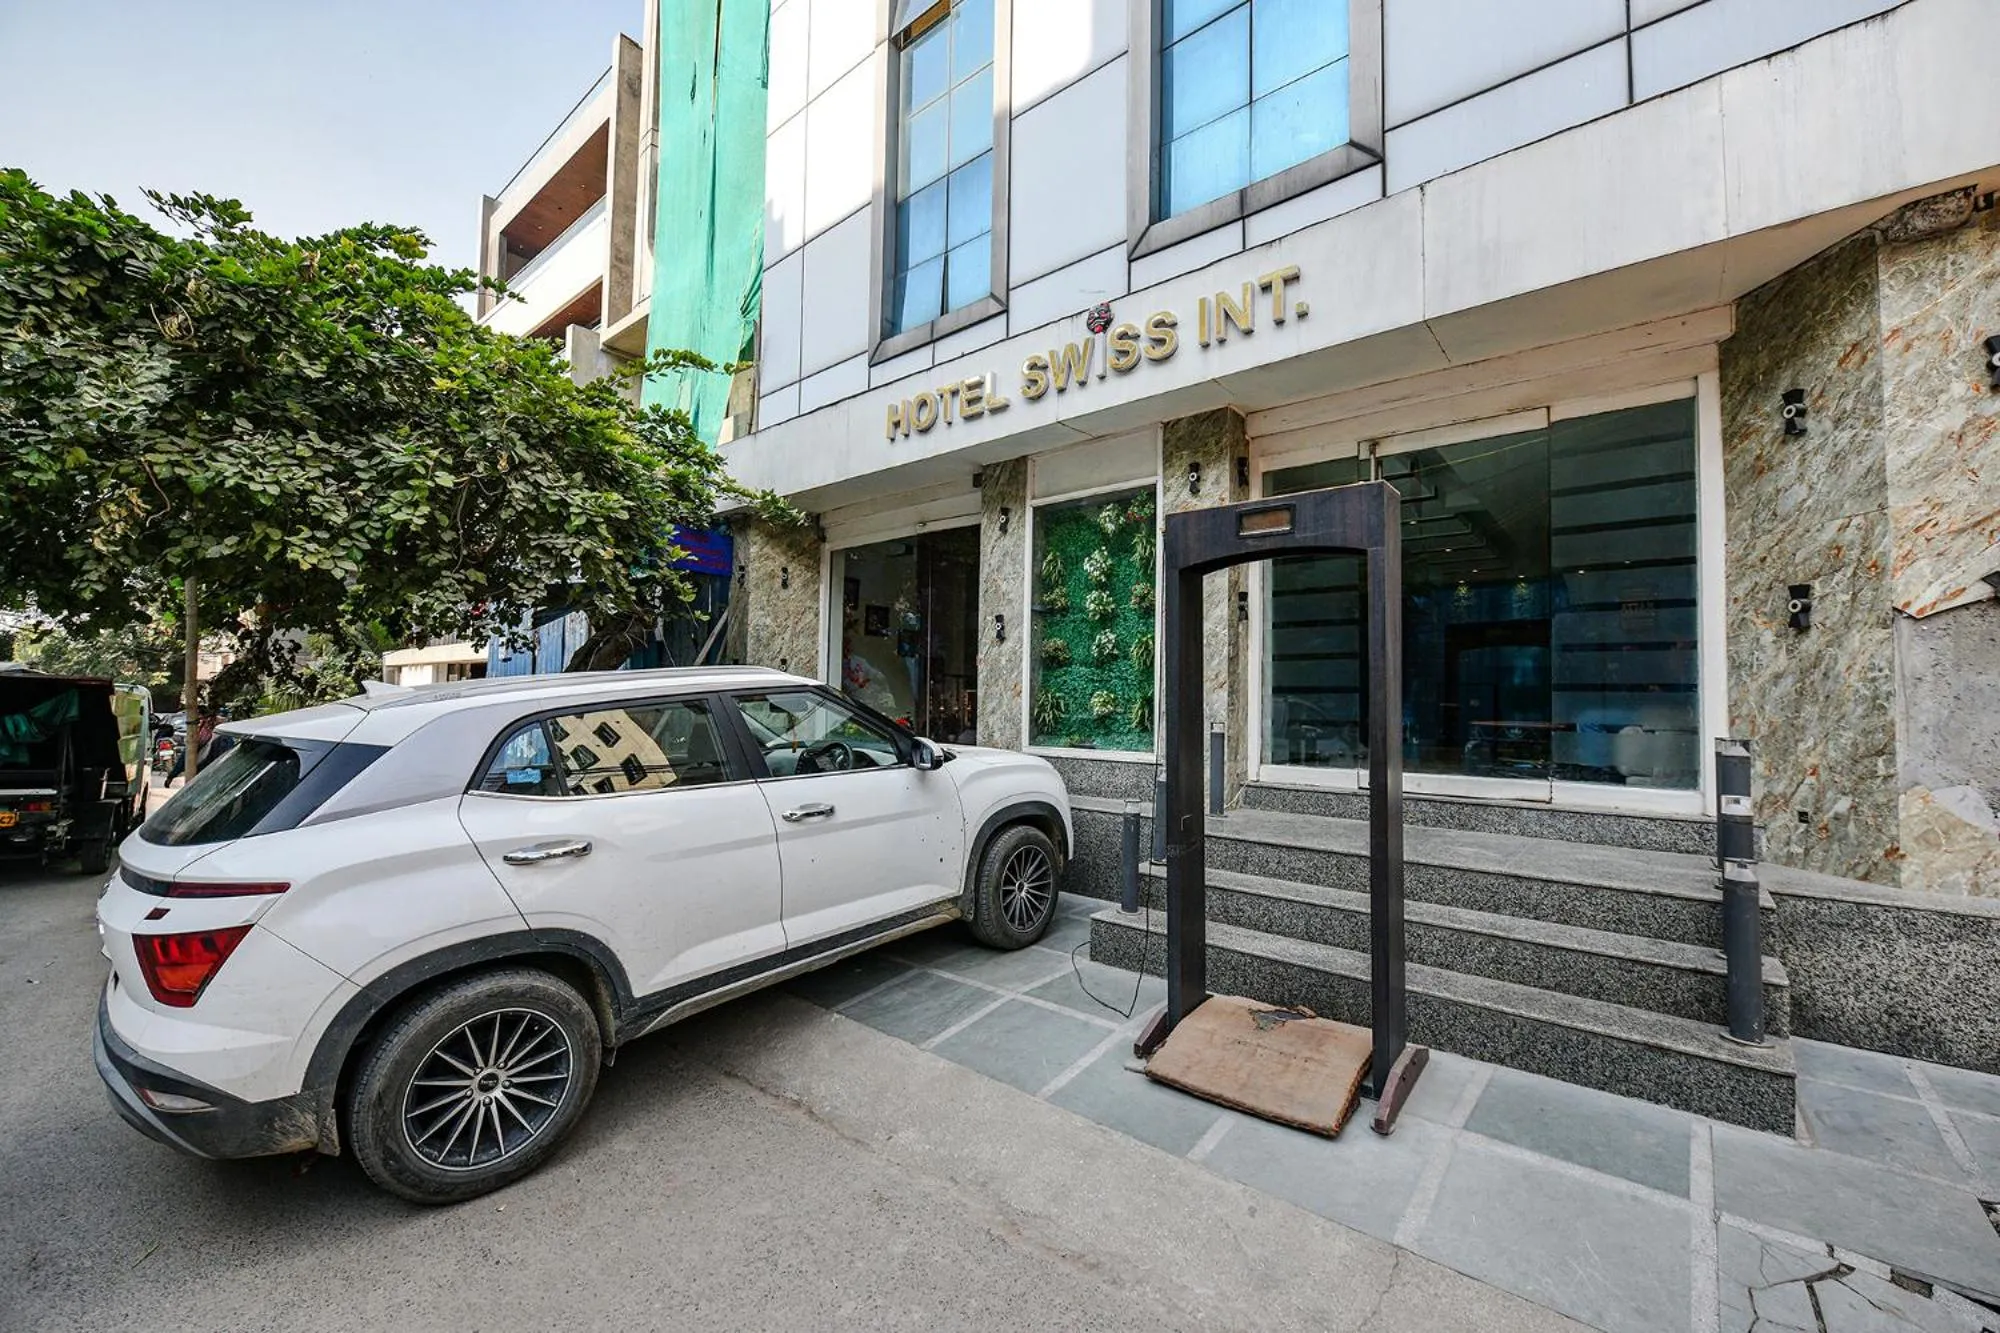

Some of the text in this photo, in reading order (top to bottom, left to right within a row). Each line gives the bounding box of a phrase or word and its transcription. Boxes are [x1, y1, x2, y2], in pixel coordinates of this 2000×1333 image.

[885, 265, 1309, 440] HOTEL SWISS INT.
